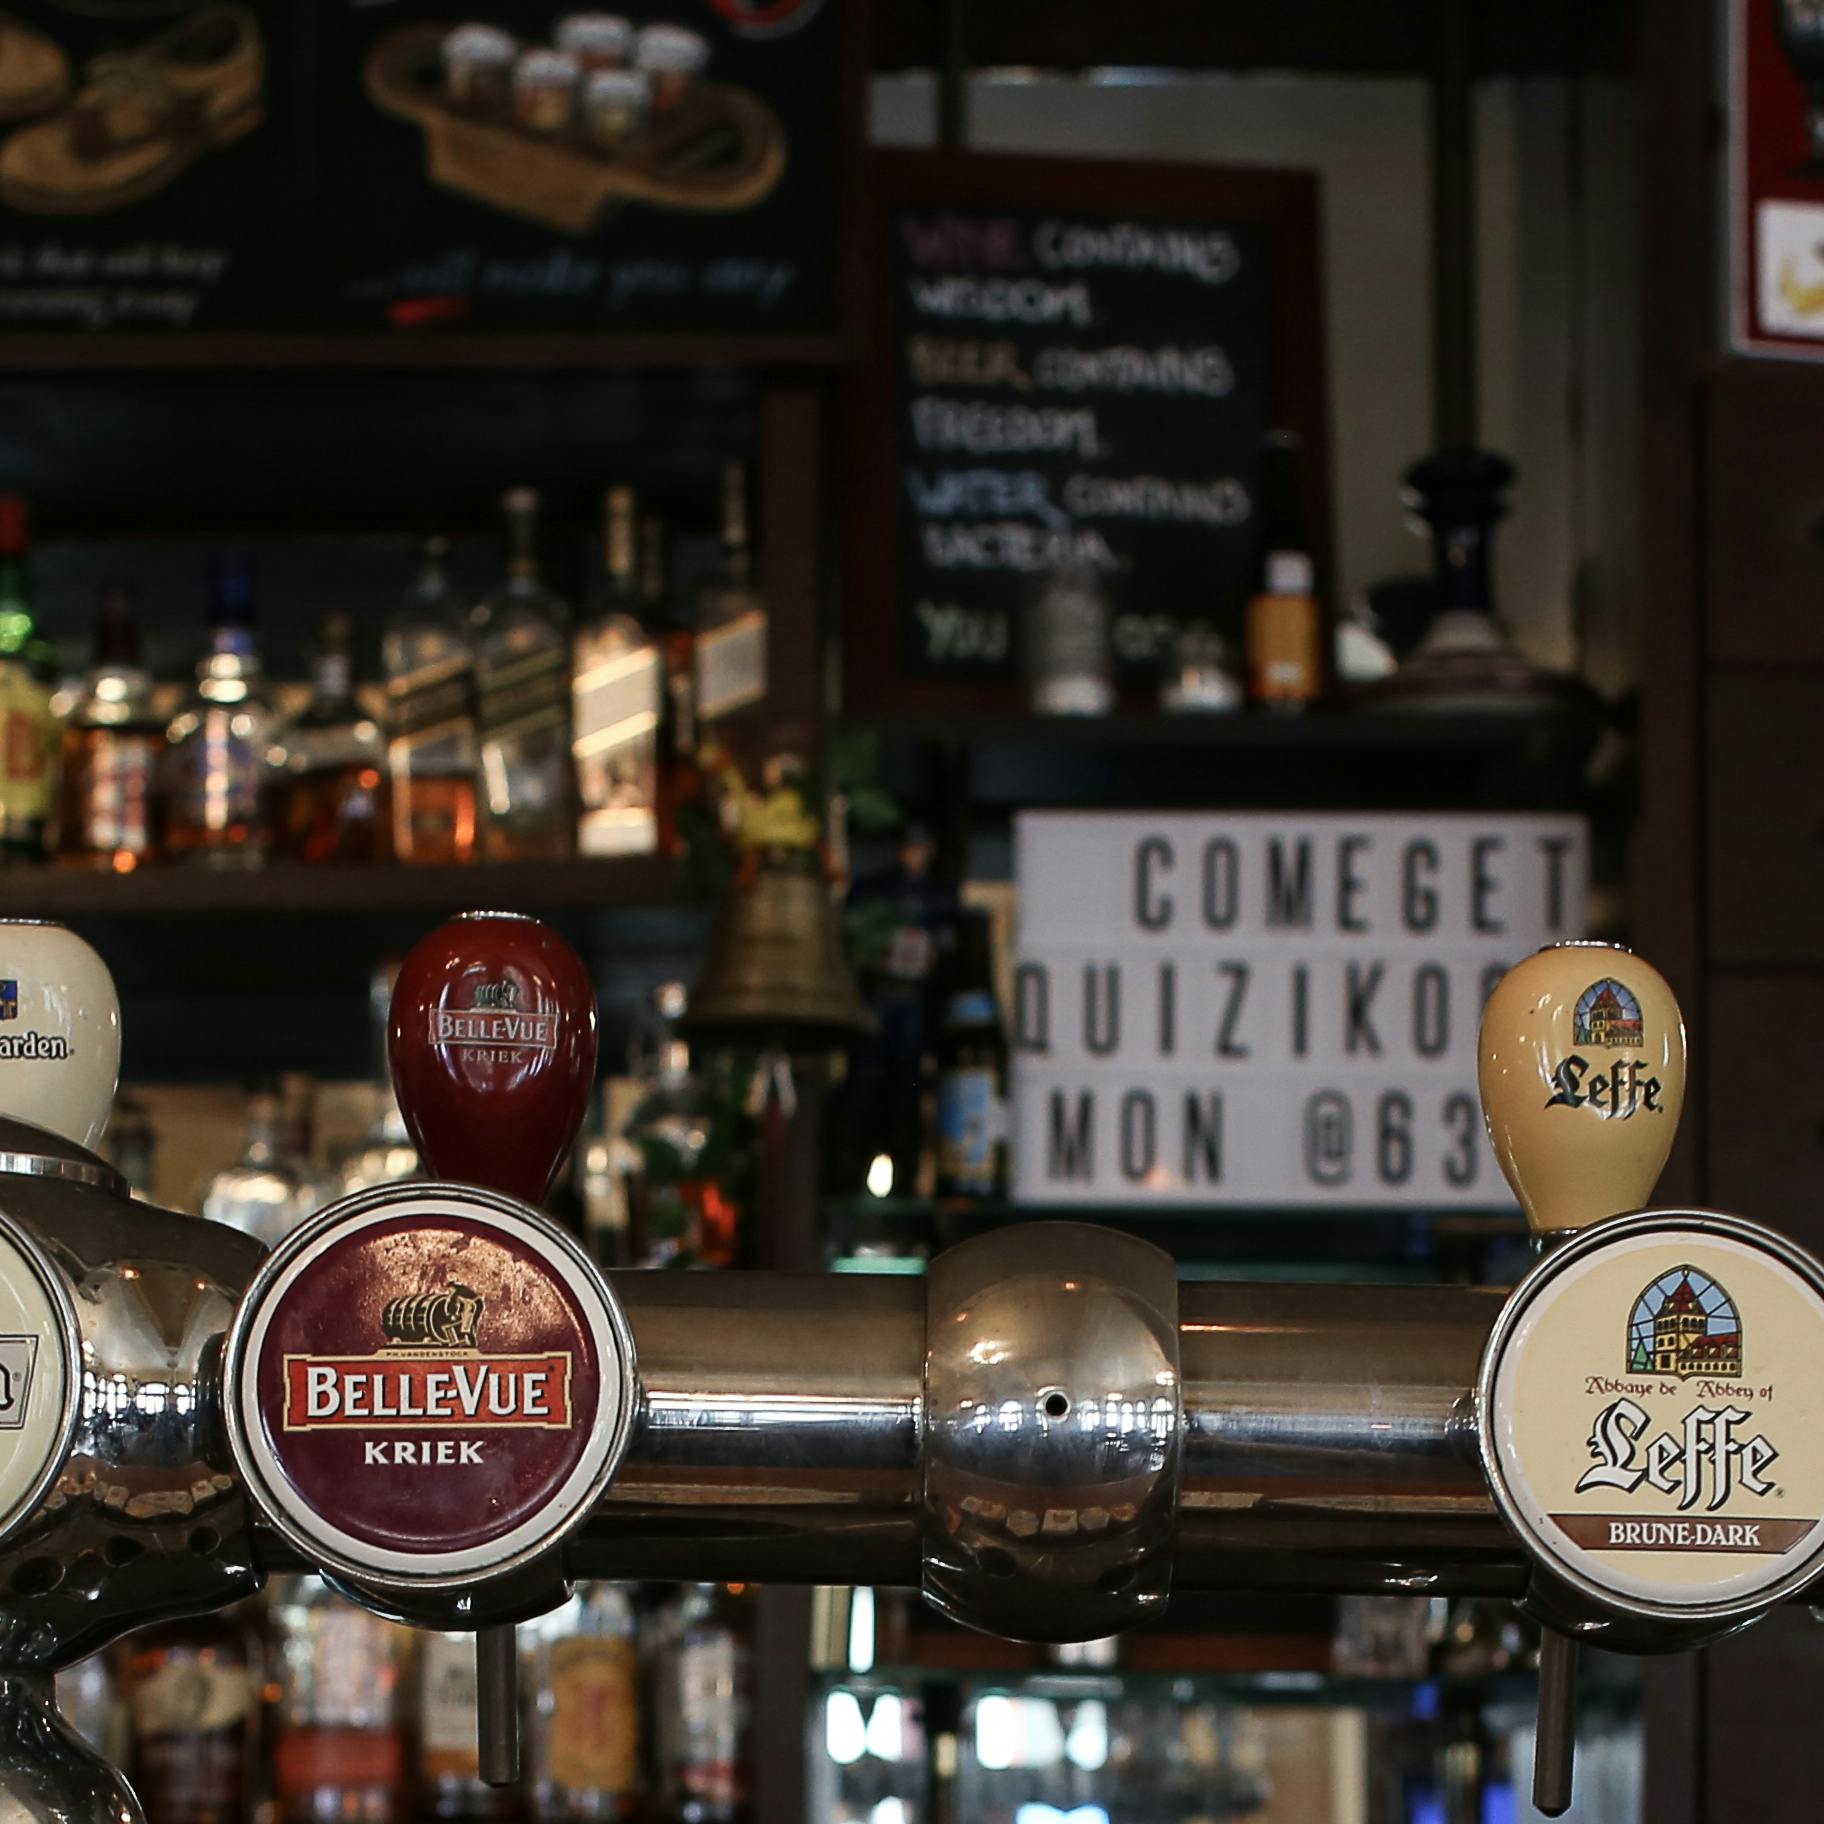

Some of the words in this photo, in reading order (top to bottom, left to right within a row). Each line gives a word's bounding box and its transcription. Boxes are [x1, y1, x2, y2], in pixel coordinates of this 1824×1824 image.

[438, 1014, 548, 1043] BELLE-VUE
[461, 1048, 524, 1064] KRIEK
[1048, 1088, 1224, 1186] MON
[306, 1363, 550, 1418] BELLE-VUE
[1584, 1376, 1656, 1399] Abbaye
[1658, 1381, 1677, 1397] de
[1695, 1379, 1754, 1401] Abbey
[1759, 1384, 1775, 1402] of
[363, 1440, 486, 1466] KRIEK
[1574, 1397, 1780, 1512] Leffe
[1607, 1520, 1762, 1547] BRUNE-DARK
